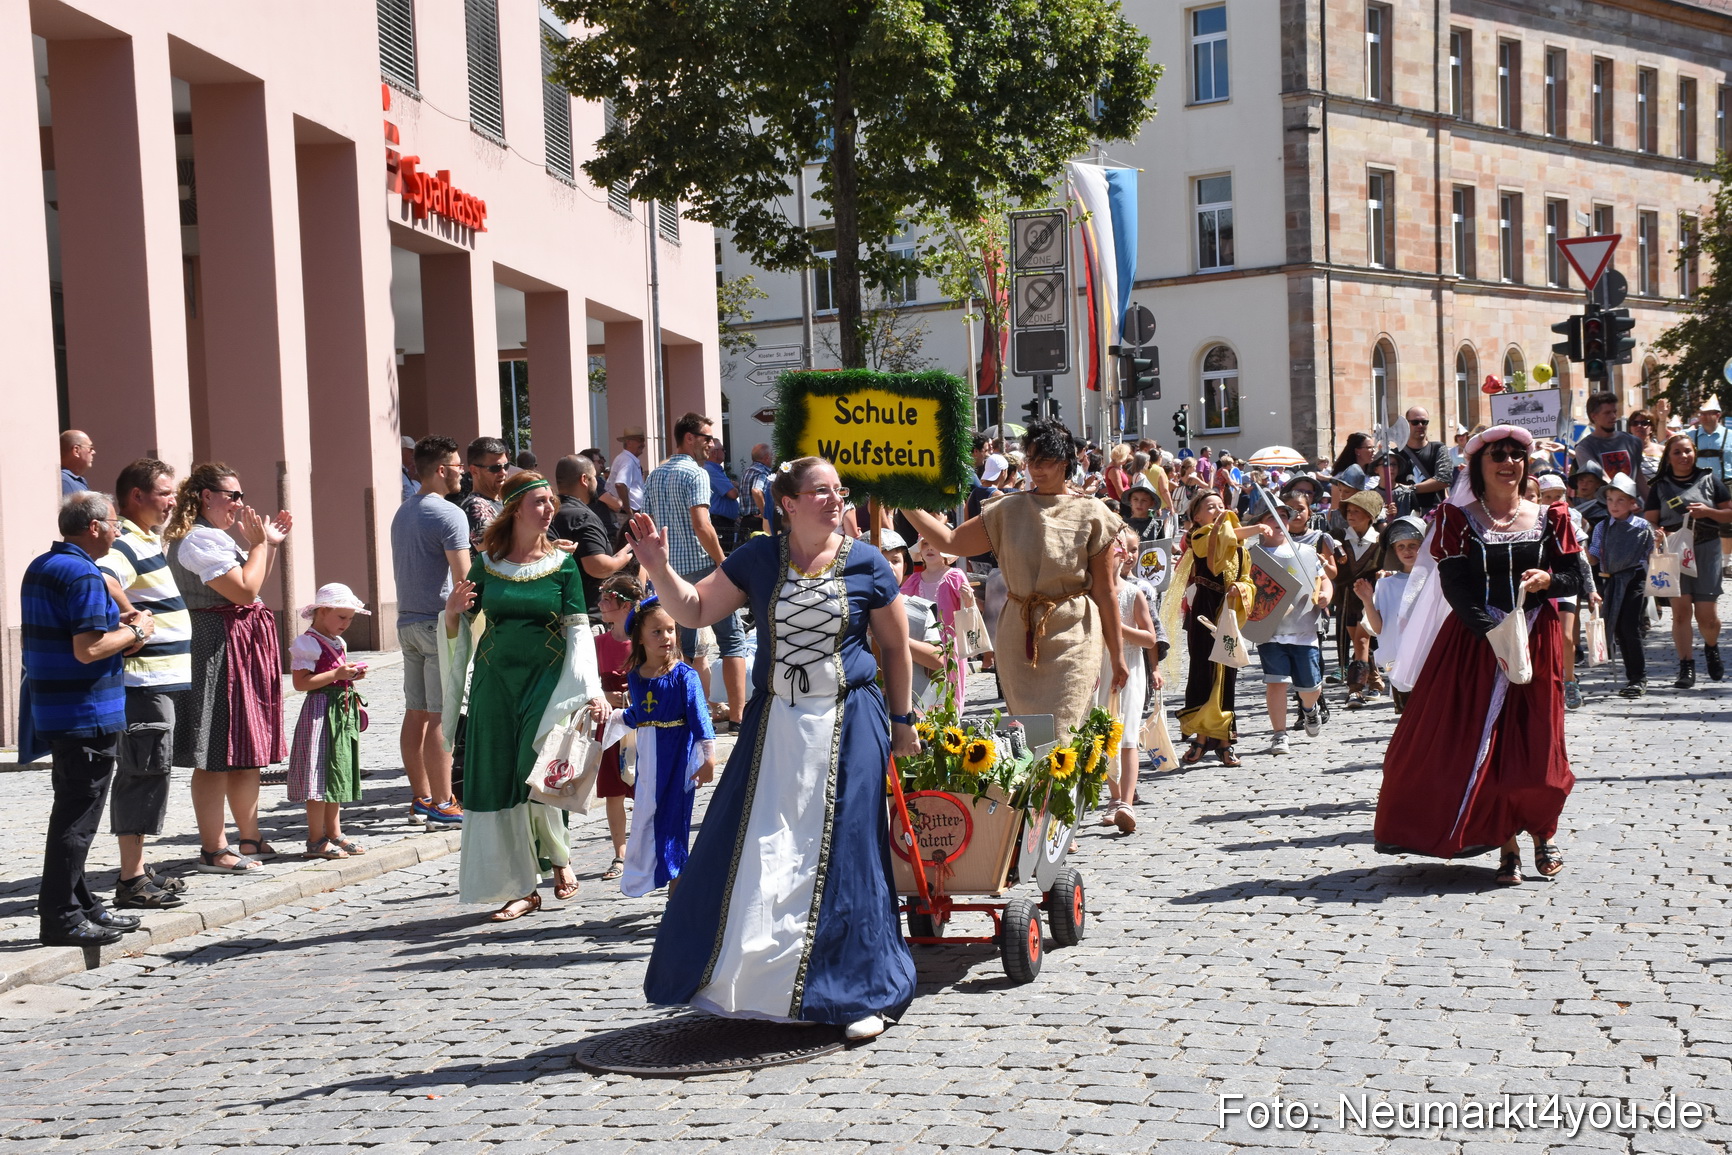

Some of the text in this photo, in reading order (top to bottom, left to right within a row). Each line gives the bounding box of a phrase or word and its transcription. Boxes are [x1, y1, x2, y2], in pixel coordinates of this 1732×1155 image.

[400, 155, 488, 233] Sparkasse
[1030, 229, 1049, 245] 30
[1028, 255, 1052, 265] ZONE
[1028, 313, 1053, 323] ZONE
[756, 369, 780, 377] Berufliche
[834, 396, 918, 425] Schule
[1527, 427, 1551, 436] heim
[817, 439, 936, 468] Wolfstein
